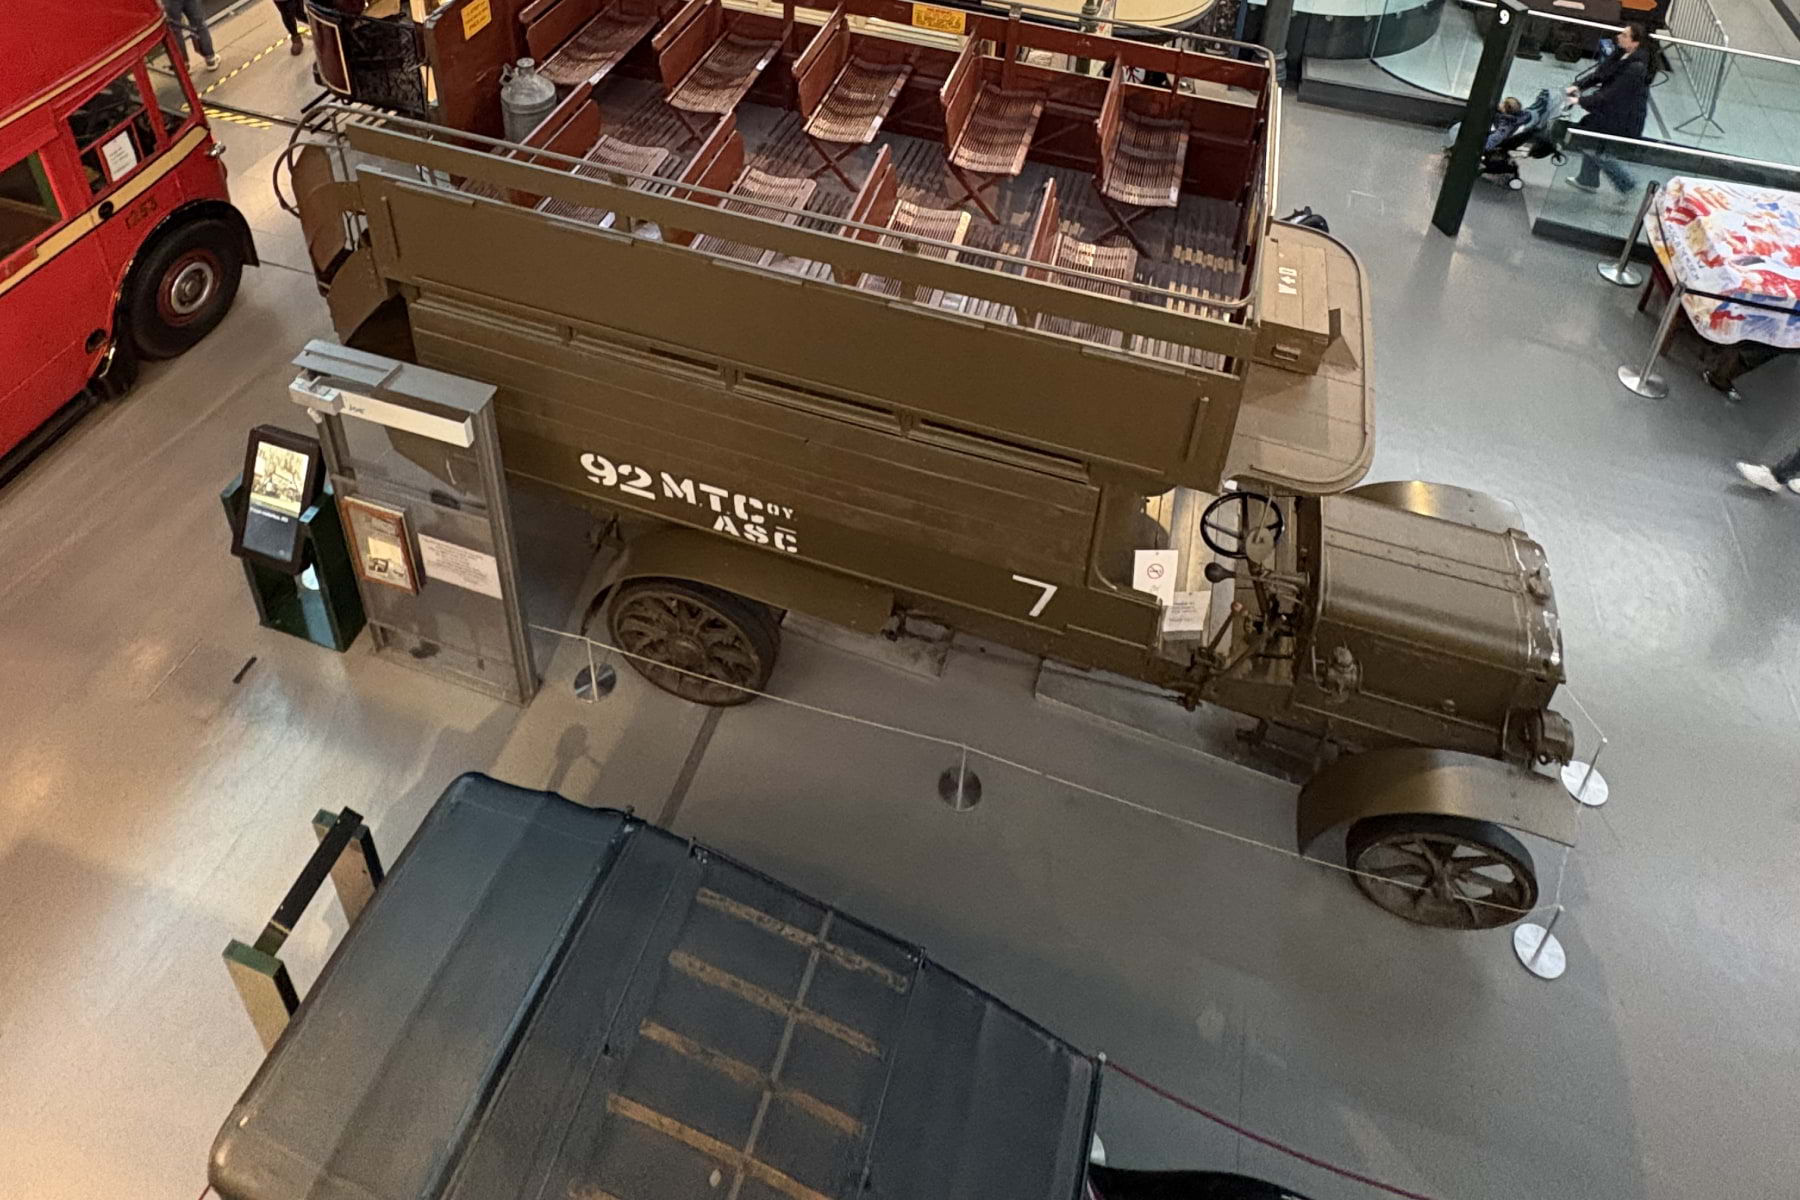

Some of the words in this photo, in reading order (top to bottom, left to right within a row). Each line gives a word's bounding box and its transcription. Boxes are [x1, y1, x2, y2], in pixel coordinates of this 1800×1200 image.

[1499, 9, 1510, 25] 9
[580, 453, 656, 501] 92
[1012, 574, 1058, 617] 7
